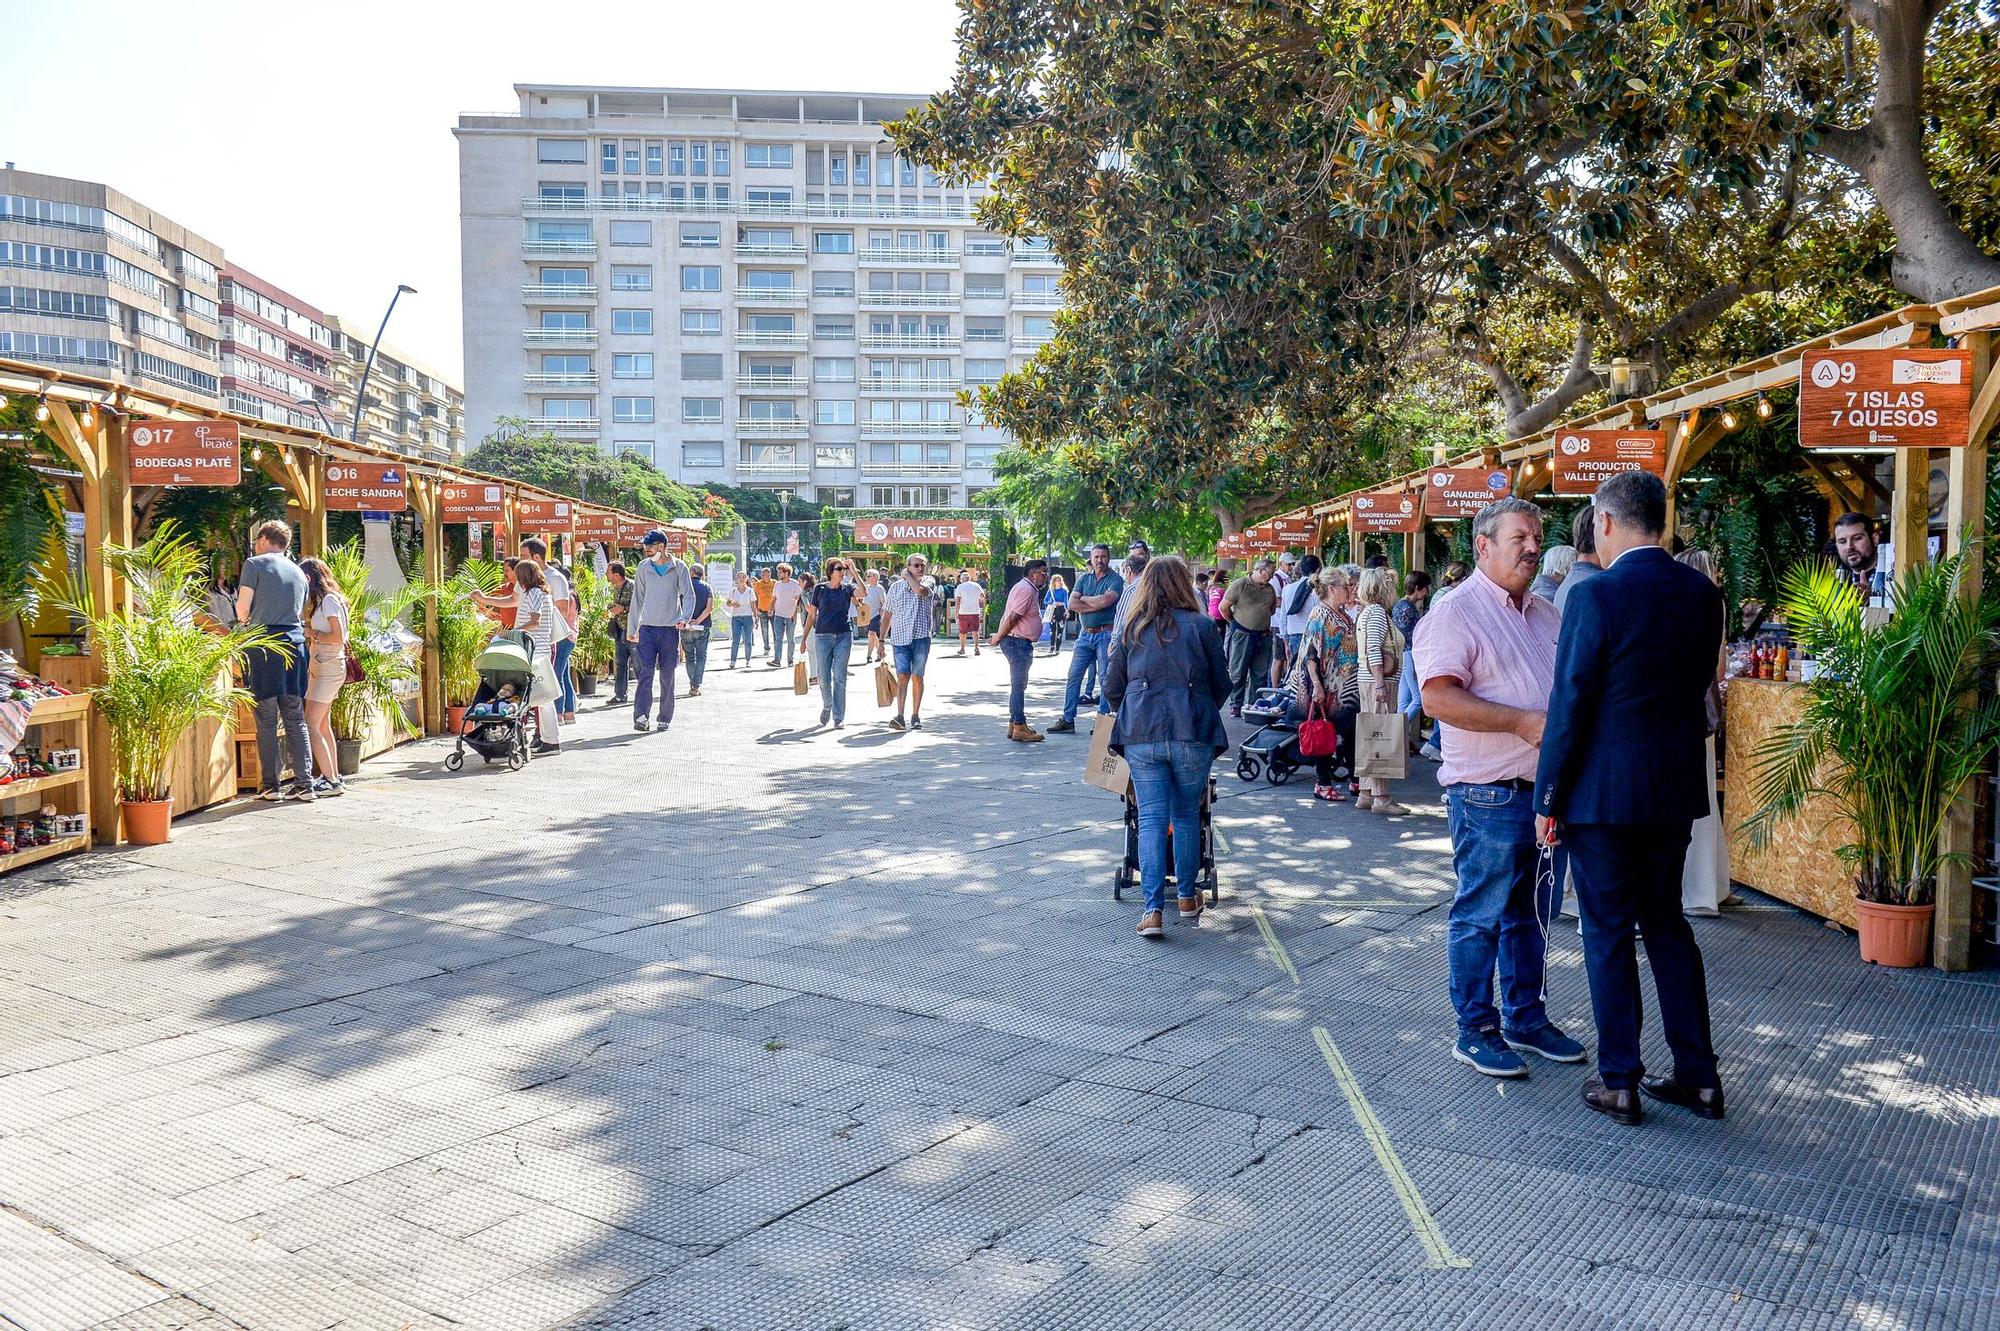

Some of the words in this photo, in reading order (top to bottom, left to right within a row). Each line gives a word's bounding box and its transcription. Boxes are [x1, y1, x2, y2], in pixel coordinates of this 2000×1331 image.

[1845, 391, 1858, 408] 7
[1863, 391, 1925, 408] ISLAS
[1831, 410, 1843, 427] 7
[1848, 409, 1938, 427] QUESOS
[153, 428, 174, 443] 17
[135, 458, 193, 467] BODEGAS
[195, 456, 232, 467] PLATÉ
[1578, 461, 1641, 471] PRODUCTOS
[342, 468, 358, 479] 16
[1564, 472, 1596, 481] VALLE
[325, 488, 359, 497] LECHE
[361, 488, 404, 498] SANDRA
[455, 489, 467, 498] 15
[1443, 490, 1495, 499] GANADERÍA
[1447, 500, 1459, 508] LA
[1460, 500, 1490, 508] PARED
[893, 526, 957, 538] MARKET
